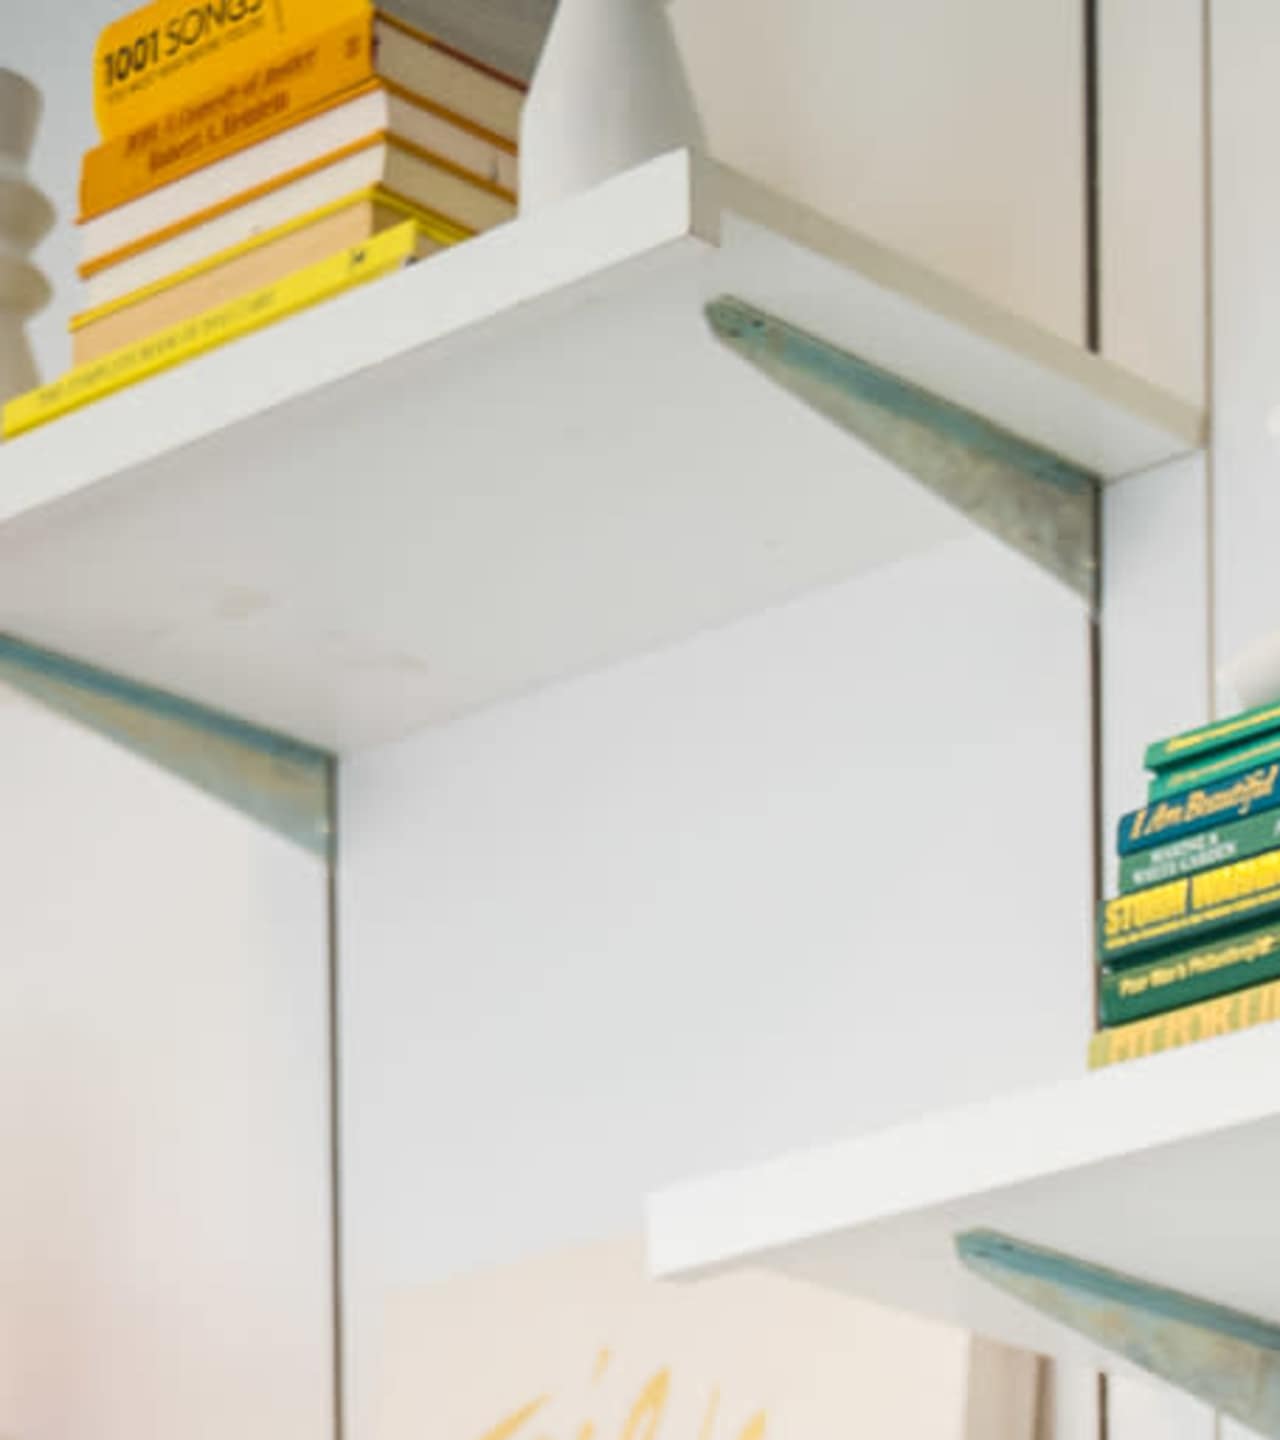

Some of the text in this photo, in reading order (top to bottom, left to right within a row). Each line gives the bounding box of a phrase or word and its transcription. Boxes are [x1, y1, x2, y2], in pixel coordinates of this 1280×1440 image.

[104, 29, 160, 87] 1001
[1184, 763, 1280, 822] Beautiful
[1104, 878, 1189, 936] STORM
